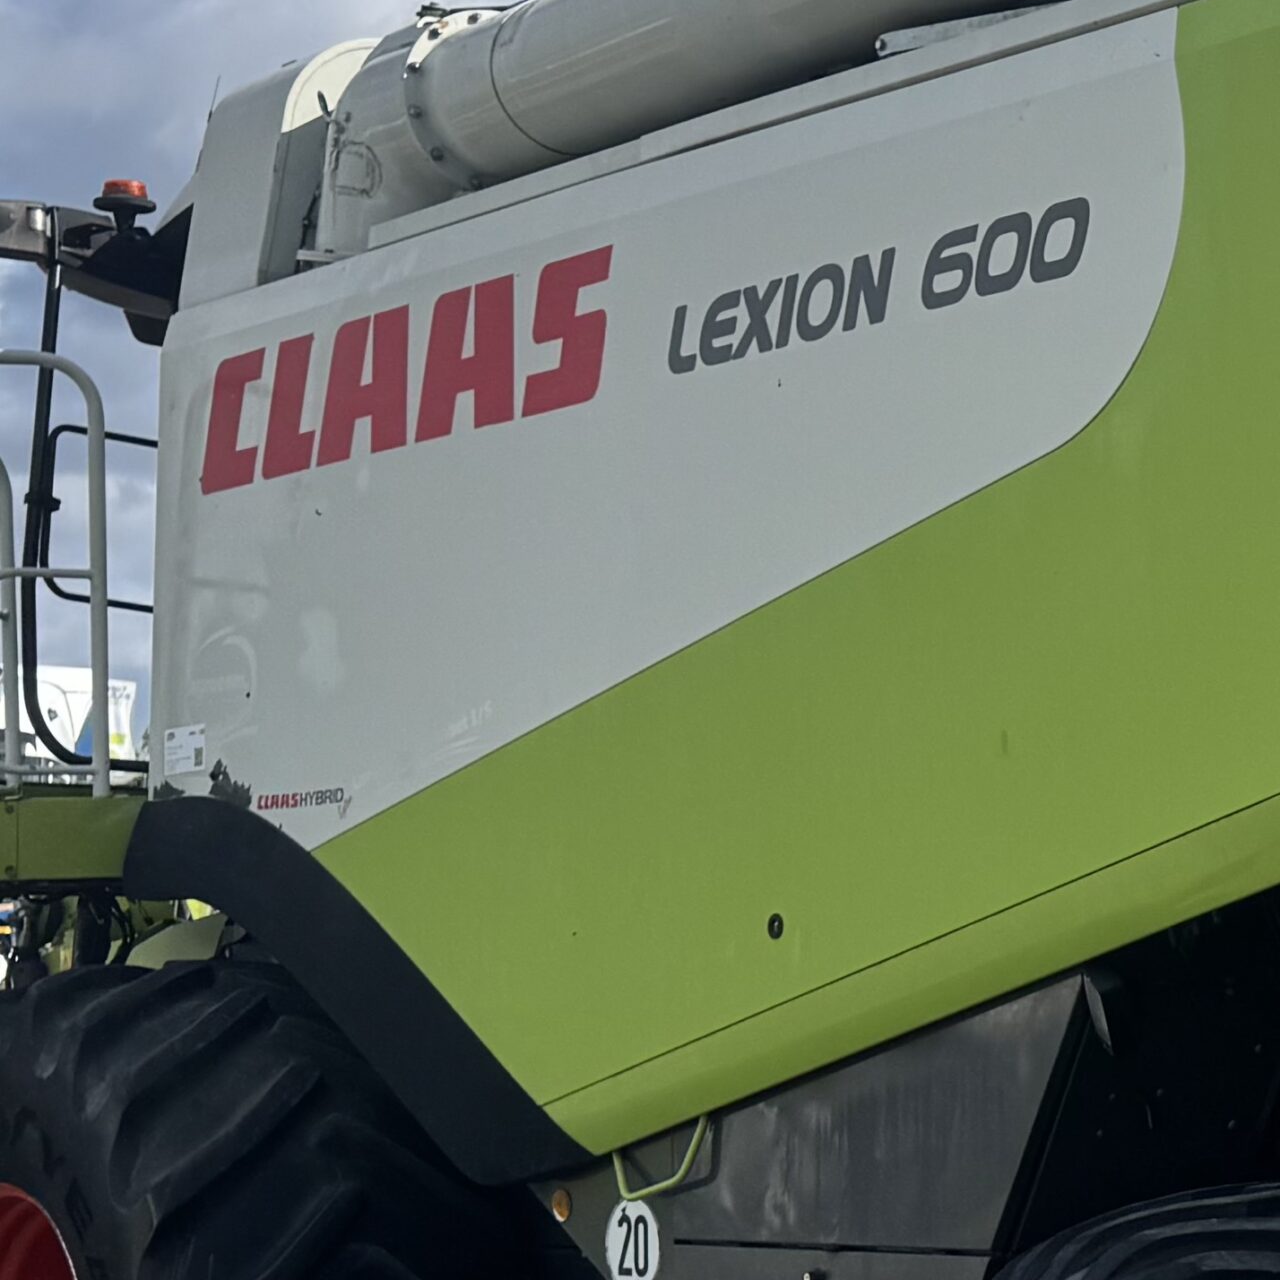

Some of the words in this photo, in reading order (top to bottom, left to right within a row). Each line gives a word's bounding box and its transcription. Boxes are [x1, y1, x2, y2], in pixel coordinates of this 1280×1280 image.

[201, 244, 614, 496] CLAAS
[667, 246, 897, 375] LEXION
[920, 196, 1091, 311] 600
[617, 1213, 649, 1278] 20
